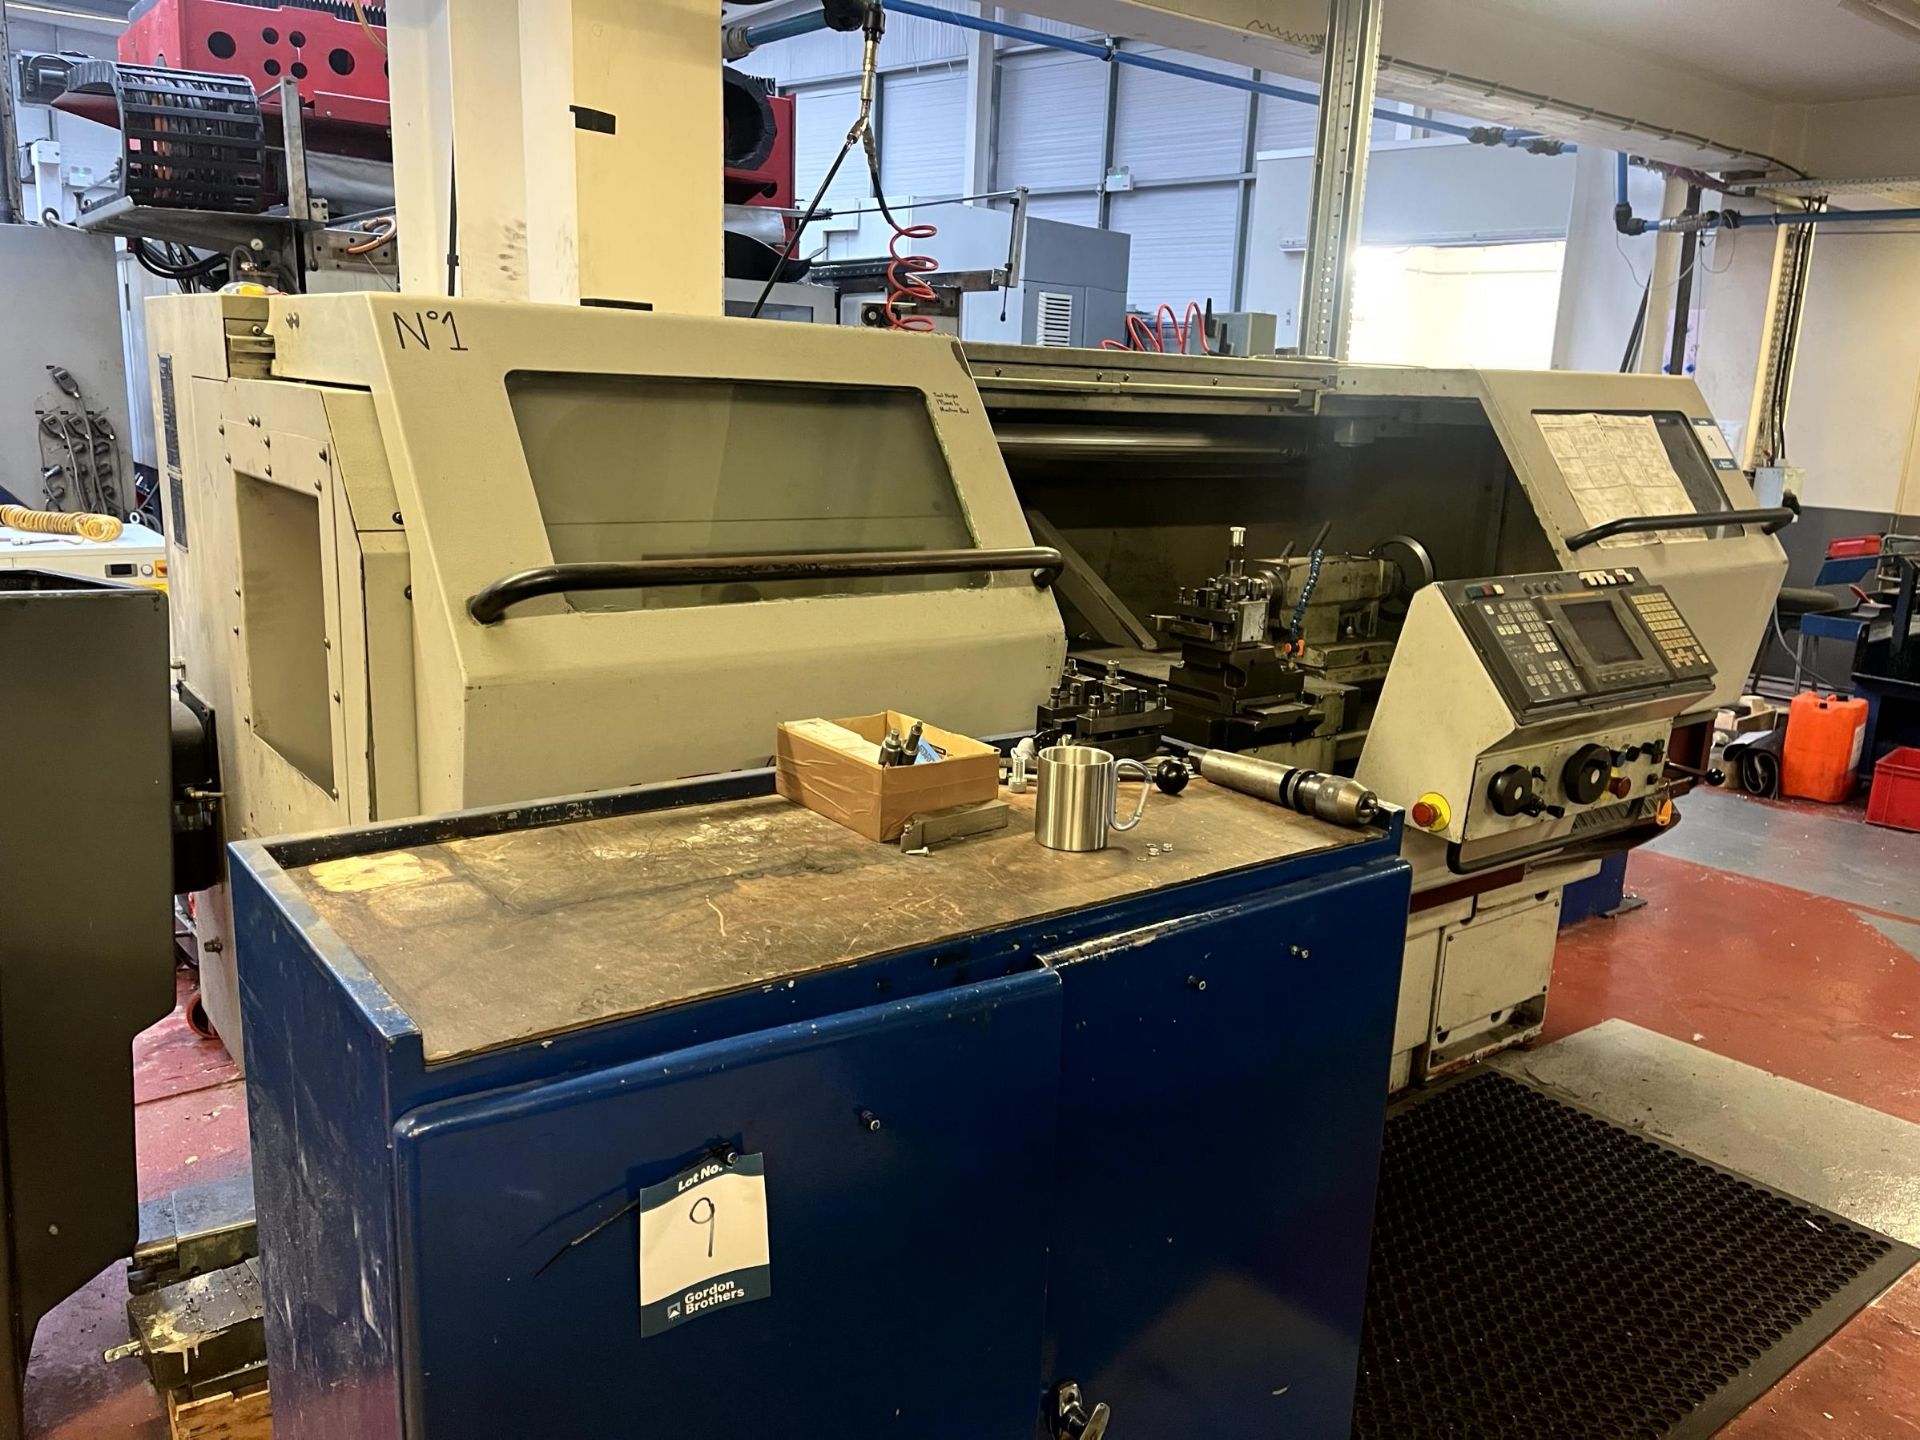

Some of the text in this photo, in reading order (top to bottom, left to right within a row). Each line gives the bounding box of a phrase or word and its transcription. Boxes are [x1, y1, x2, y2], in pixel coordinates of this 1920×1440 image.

[678, 1163, 723, 1192] Lot No.
[689, 1197, 715, 1258] 9
[684, 1280, 735, 1305] Gordon
[685, 1288, 745, 1315] Brothers
